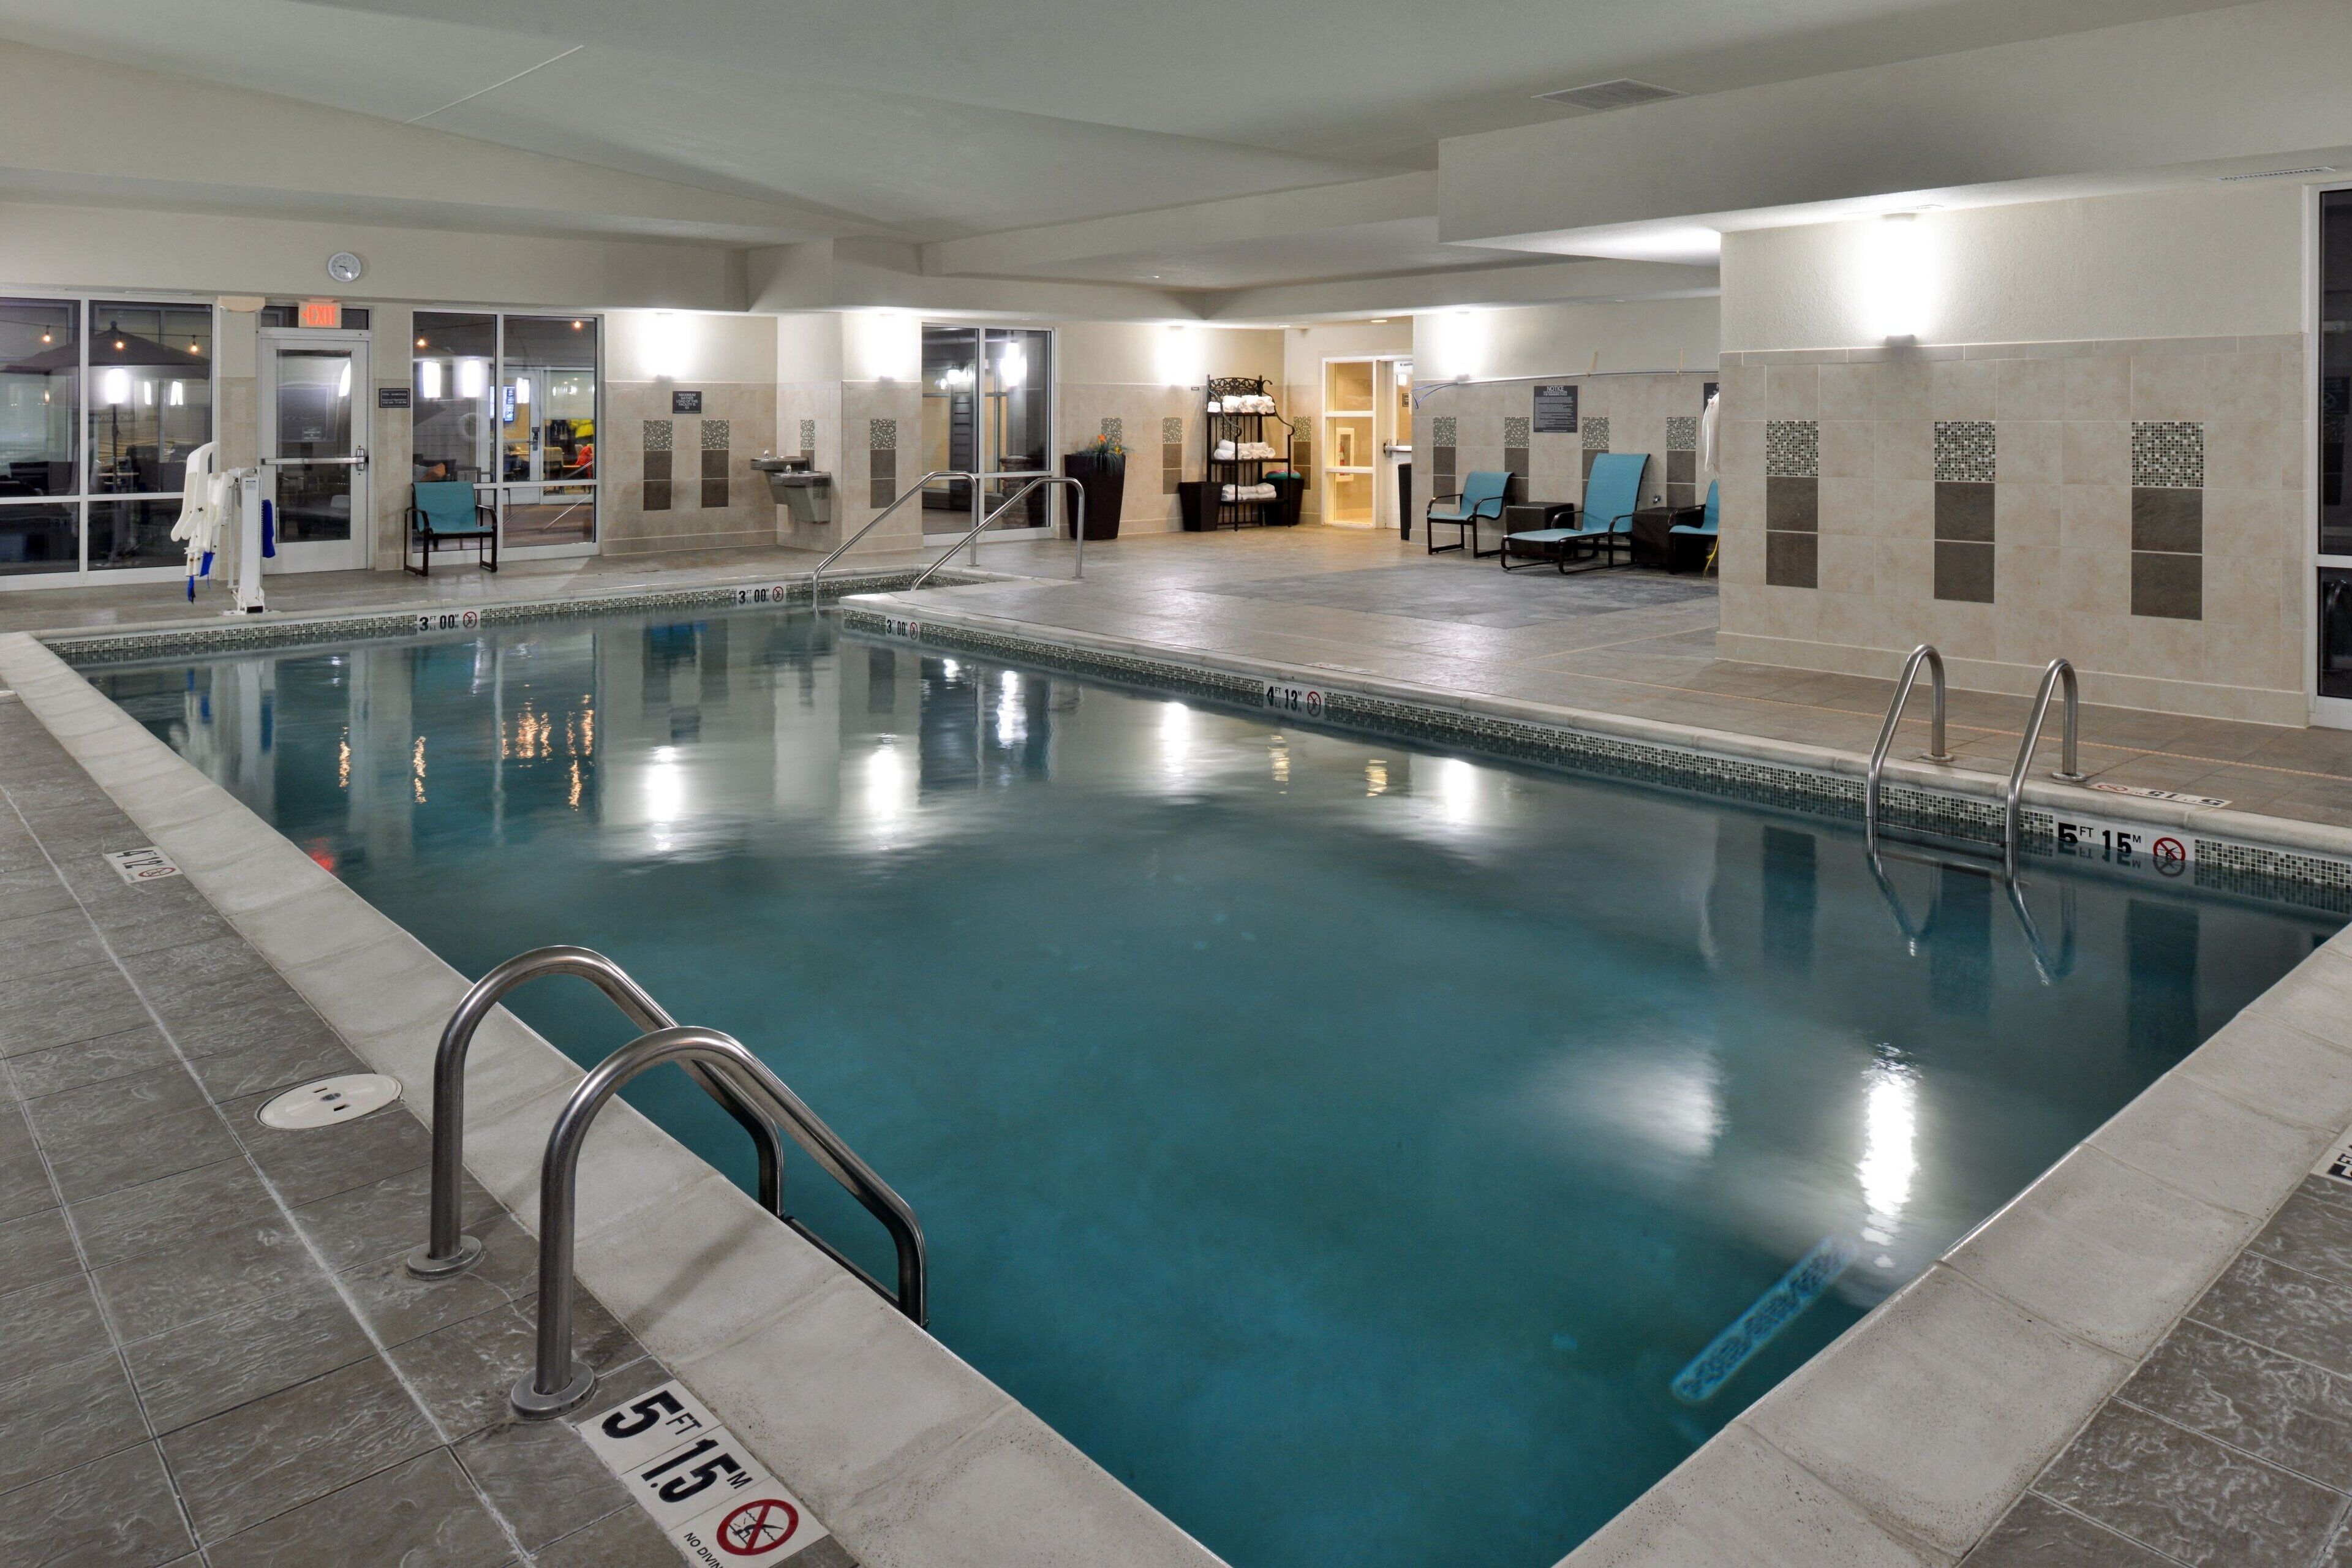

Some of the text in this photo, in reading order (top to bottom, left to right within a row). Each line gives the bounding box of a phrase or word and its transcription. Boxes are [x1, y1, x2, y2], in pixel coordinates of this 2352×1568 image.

[307, 305, 336, 325] EXIT
[2058, 822, 2078, 843] 5
[2080, 826, 2094, 837] FT
[2133, 834, 2141, 843] M
[601, 1390, 685, 1439] 5
[665, 1412, 703, 1435] FT
[726, 1471, 753, 1490] M
[684, 1532, 701, 1547] NO
